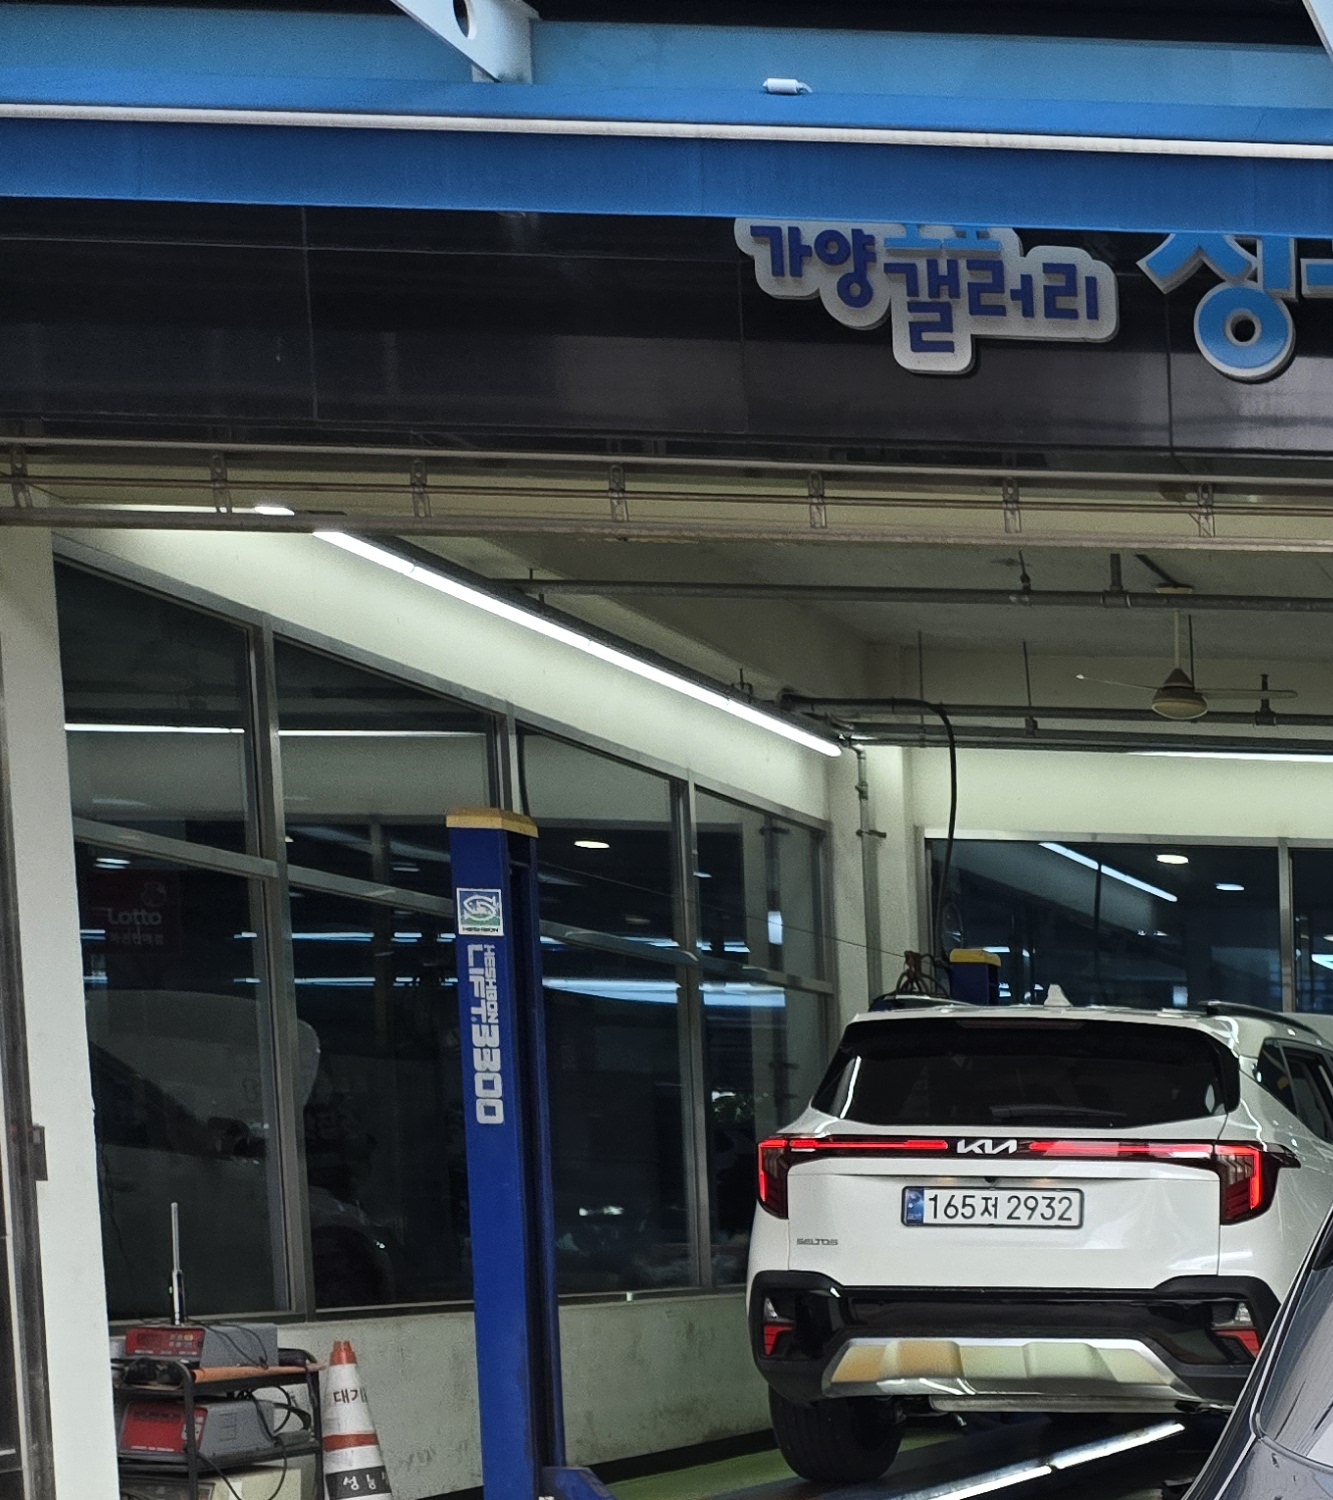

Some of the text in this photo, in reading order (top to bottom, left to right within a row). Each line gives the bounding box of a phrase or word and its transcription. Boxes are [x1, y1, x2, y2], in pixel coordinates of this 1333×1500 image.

[750, 225, 1099, 353] 가양 갤러리
[483, 944, 499, 1024] HESHBON
[471, 1023, 504, 1125] 3300
[796, 1238, 839, 1246] SELTOS
[928, 1193, 1074, 1221] 165저 2932
